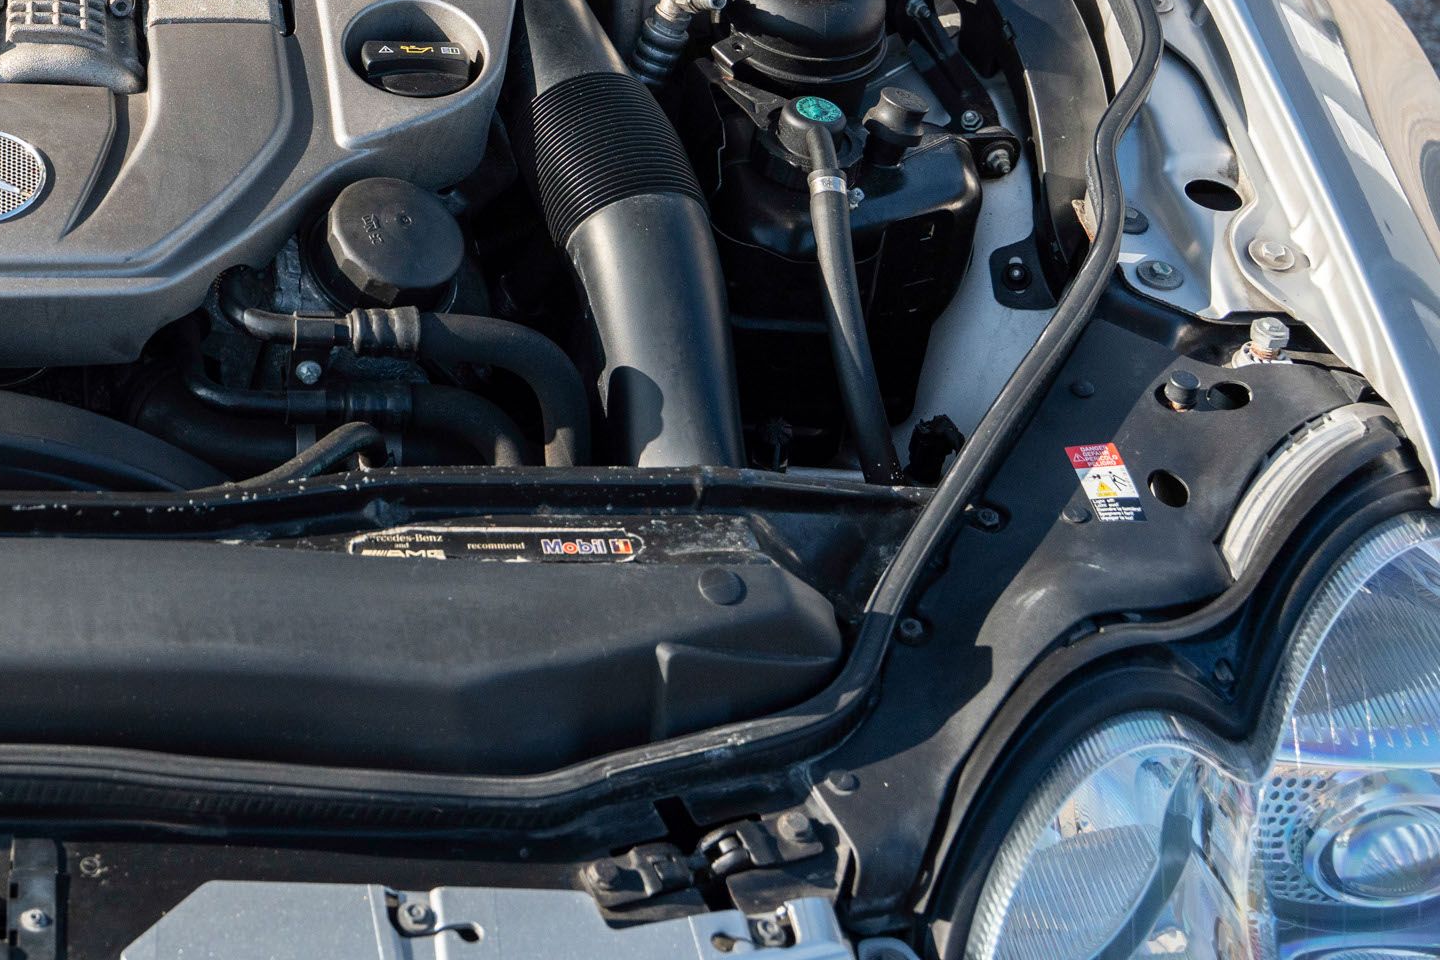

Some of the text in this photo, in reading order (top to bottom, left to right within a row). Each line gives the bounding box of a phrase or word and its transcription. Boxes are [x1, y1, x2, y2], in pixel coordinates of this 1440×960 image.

[1084, 454, 1118, 462] PERICOLO
[467, 542, 525, 551] recommend
[541, 538, 607, 554] Mobil
